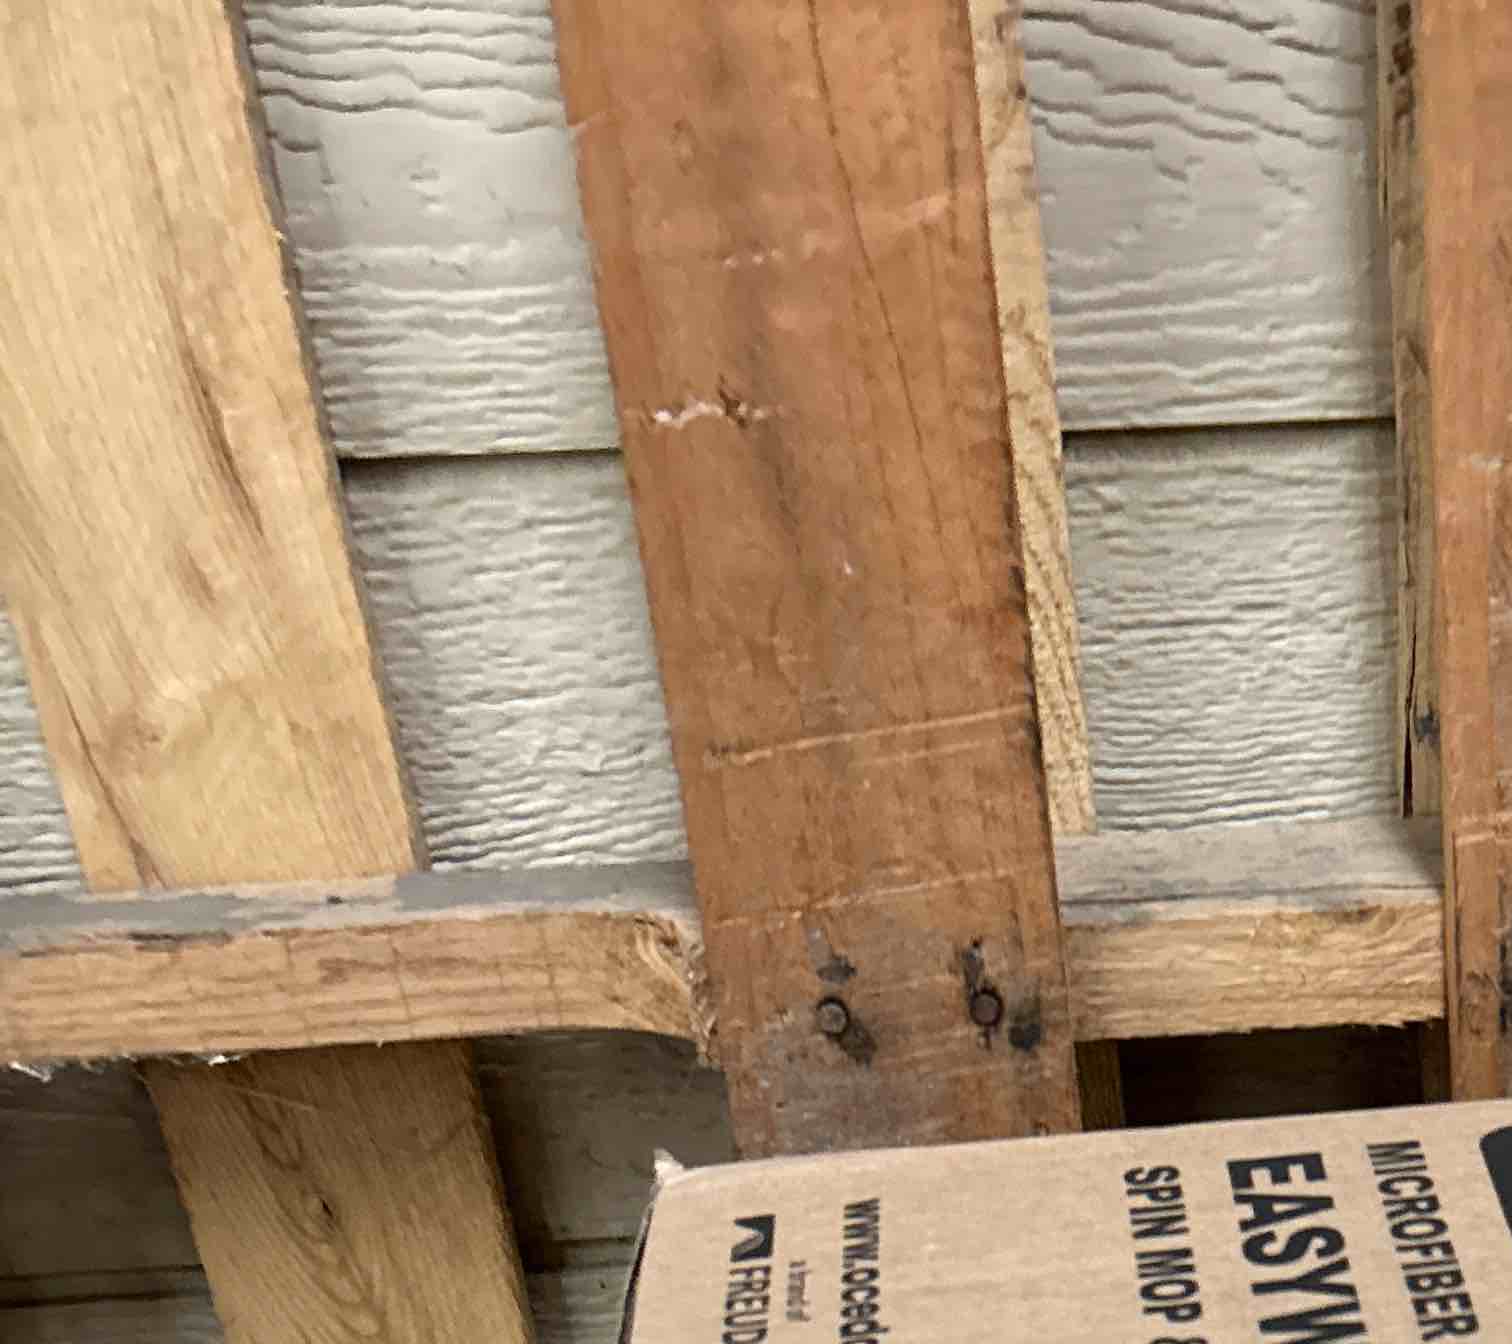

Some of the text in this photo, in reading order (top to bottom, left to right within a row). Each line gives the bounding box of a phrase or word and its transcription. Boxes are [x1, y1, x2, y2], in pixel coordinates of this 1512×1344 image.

[1124, 1165, 1184, 1240] SPIN
[1366, 1139, 1479, 1343] MICROFIBER
[1135, 1247, 1201, 1324] MOP
